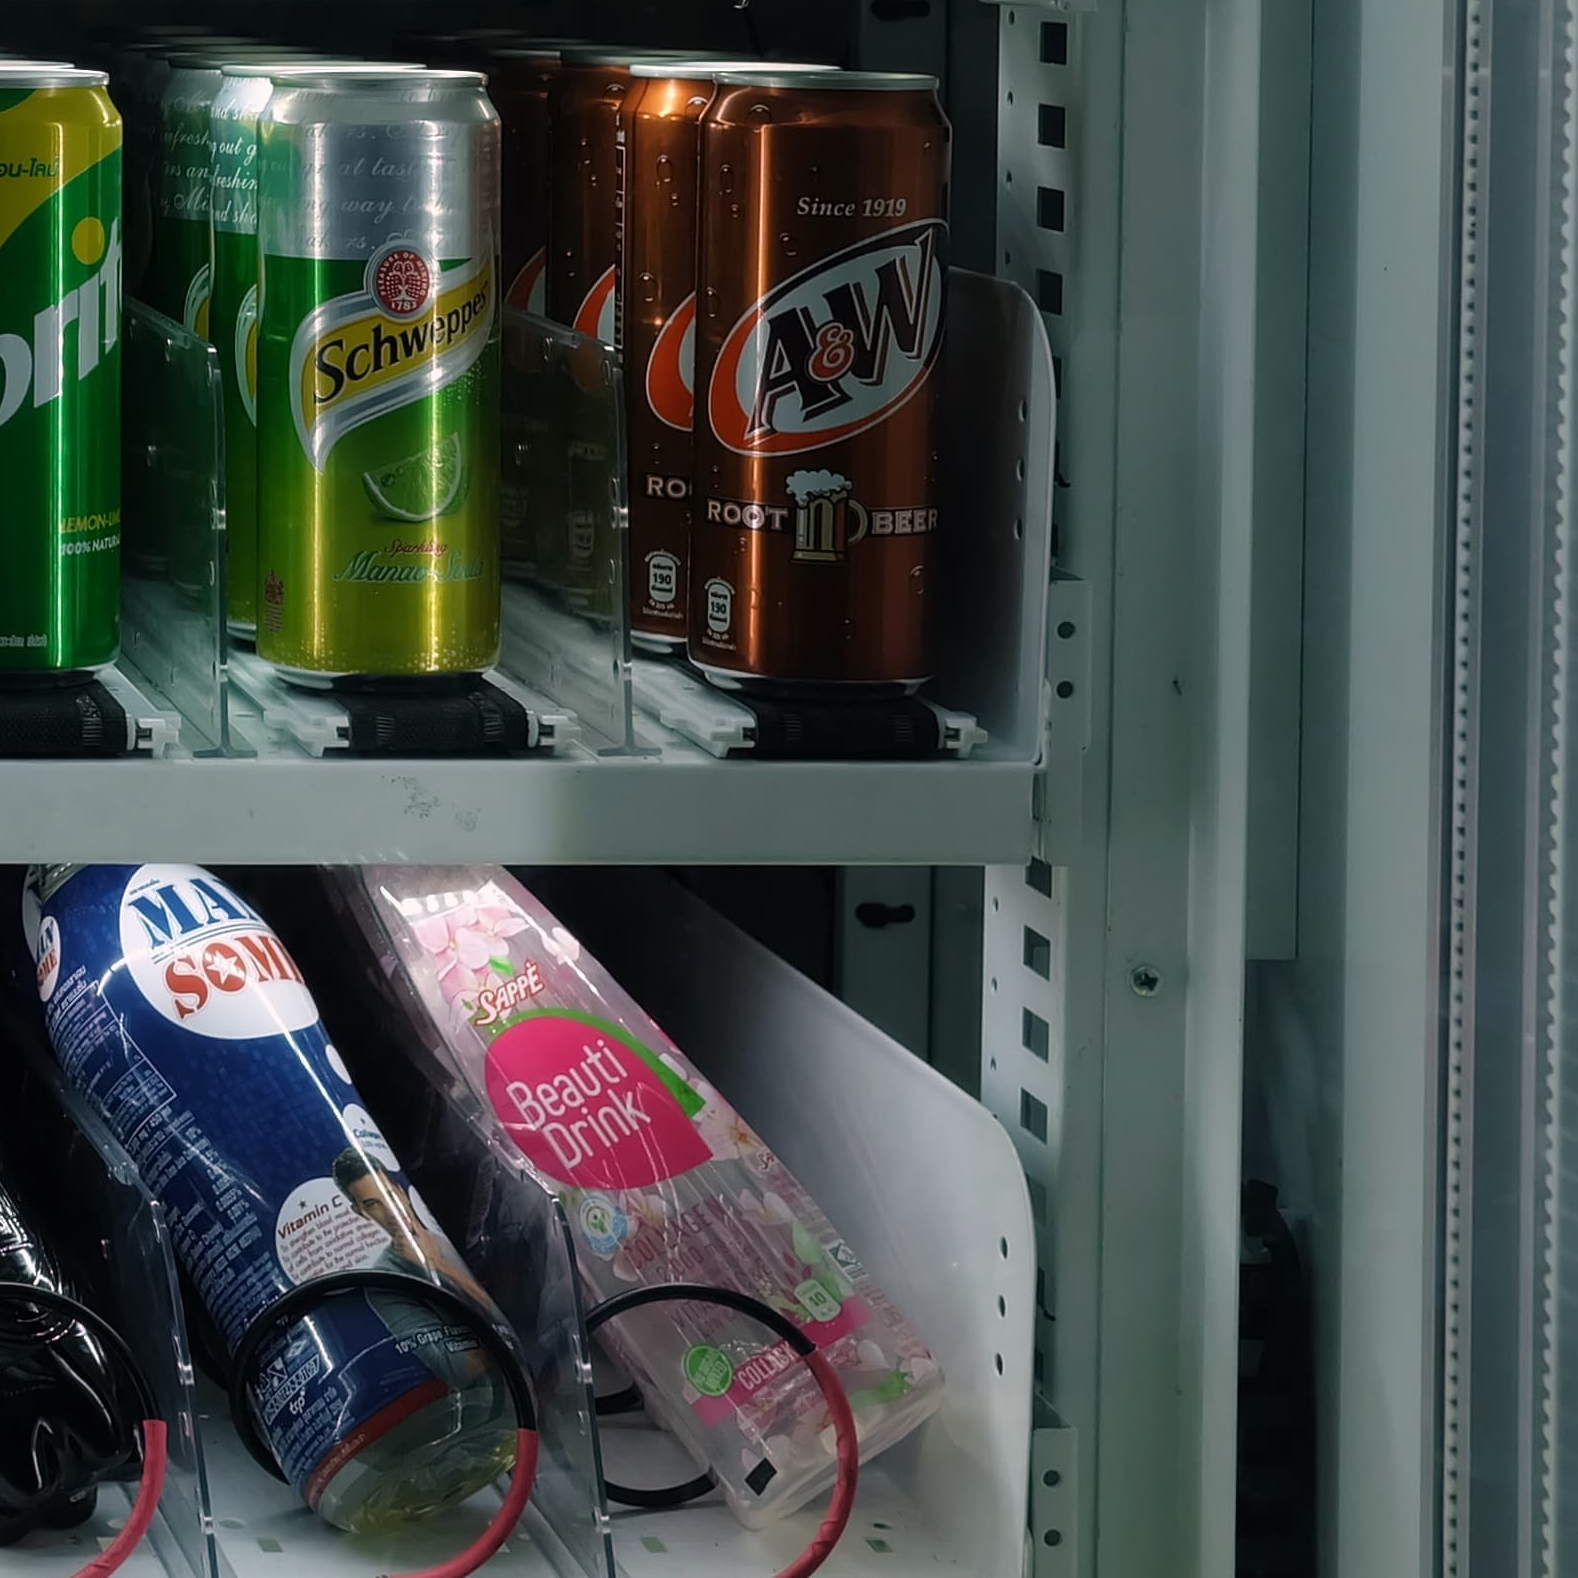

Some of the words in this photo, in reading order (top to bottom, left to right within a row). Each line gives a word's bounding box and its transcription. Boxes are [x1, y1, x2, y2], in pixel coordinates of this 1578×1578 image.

[796, 195, 856, 218] Since
[862, 195, 909, 219] 1919
[391, 299, 418, 311] 1783
[314, 284, 489, 405] Schweppes
[743, 226, 936, 443] A&W
[706, 498, 789, 531] ROOT
[871, 506, 939, 535] BEER
[59, 538, 92, 558] 100%
[385, 537, 448, 558] Sparkling
[332, 549, 426, 584] Manao
[652, 572, 673, 586] 190
[710, 601, 727, 615] 190
[127, 874, 255, 952] MA
[506, 1038, 628, 1132] Beauti
[542, 1087, 652, 1170] Drink
[278, 1198, 330, 1240] Vitamin
[807, 1290, 829, 1307] 10
[396, 1335, 418, 1355] 10%
[417, 1329, 444, 1351] Grape
